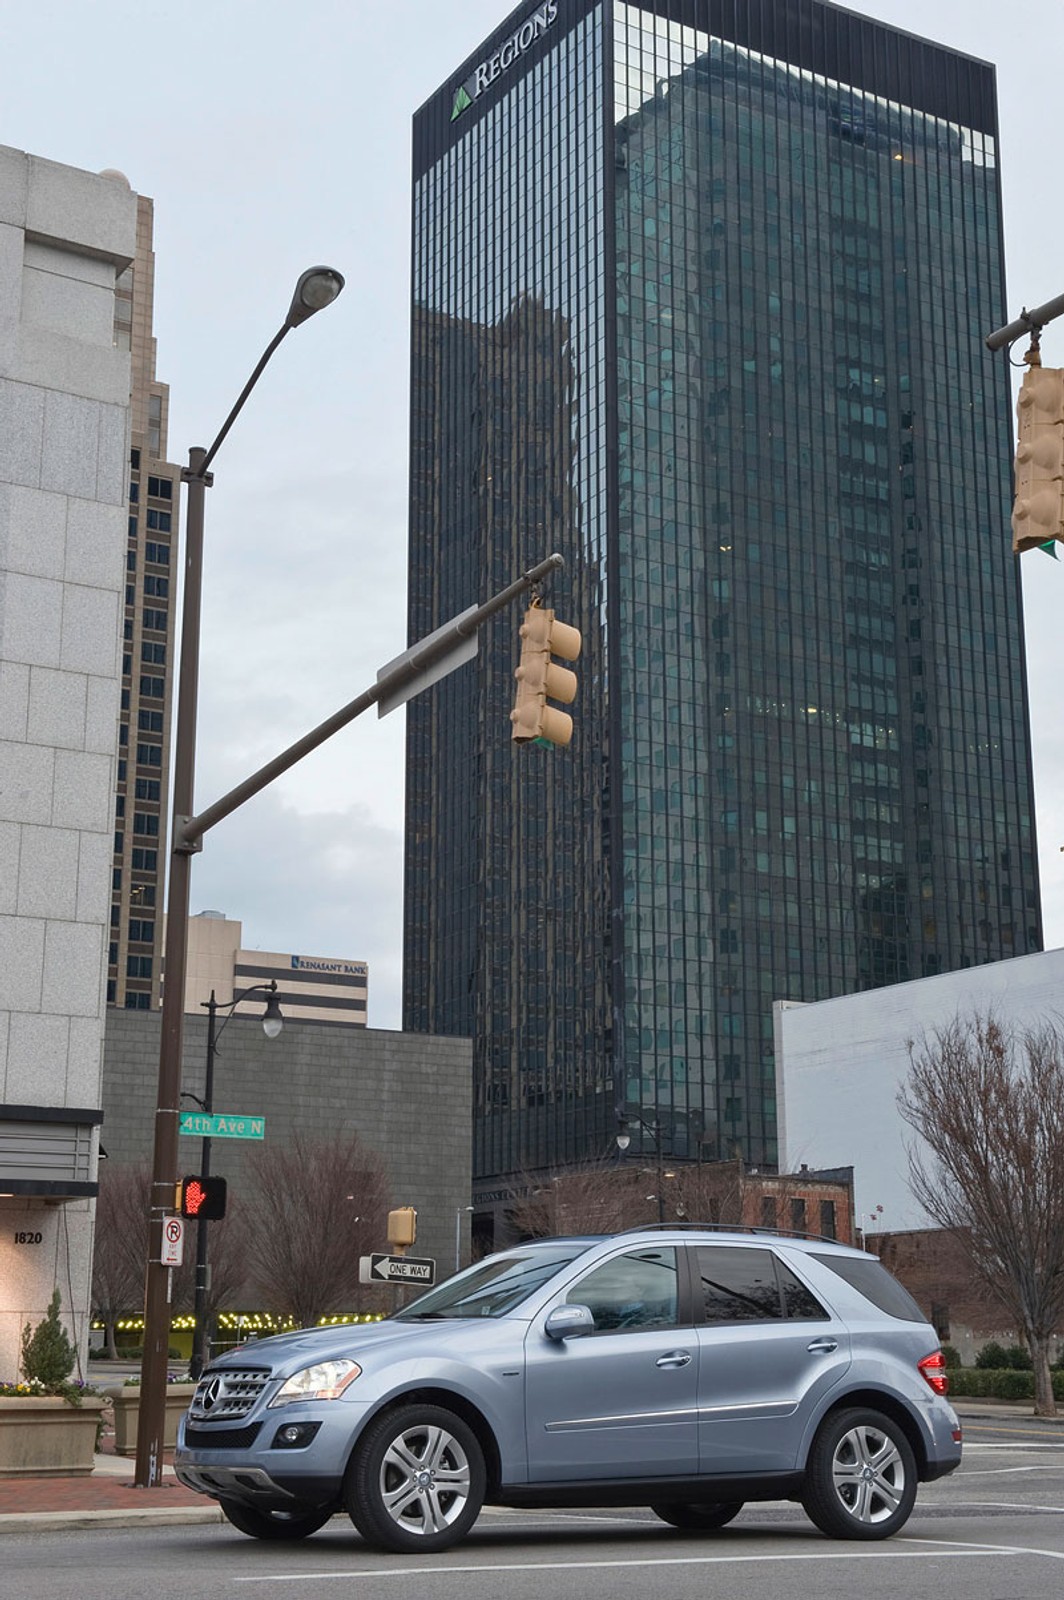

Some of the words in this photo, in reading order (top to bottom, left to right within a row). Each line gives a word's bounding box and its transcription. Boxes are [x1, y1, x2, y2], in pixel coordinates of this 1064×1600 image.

[474, 0, 558, 99] REGIONS
[300, 960, 342, 972] RENASANT
[344, 964, 366, 975] BANK
[183, 1116, 211, 1131] 4th
[217, 1118, 245, 1134] Ave
[251, 1120, 262, 1135] N
[14, 1231, 42, 1244] 1820
[389, 1263, 407, 1275] ONE
[409, 1265, 428, 1277] WAY
